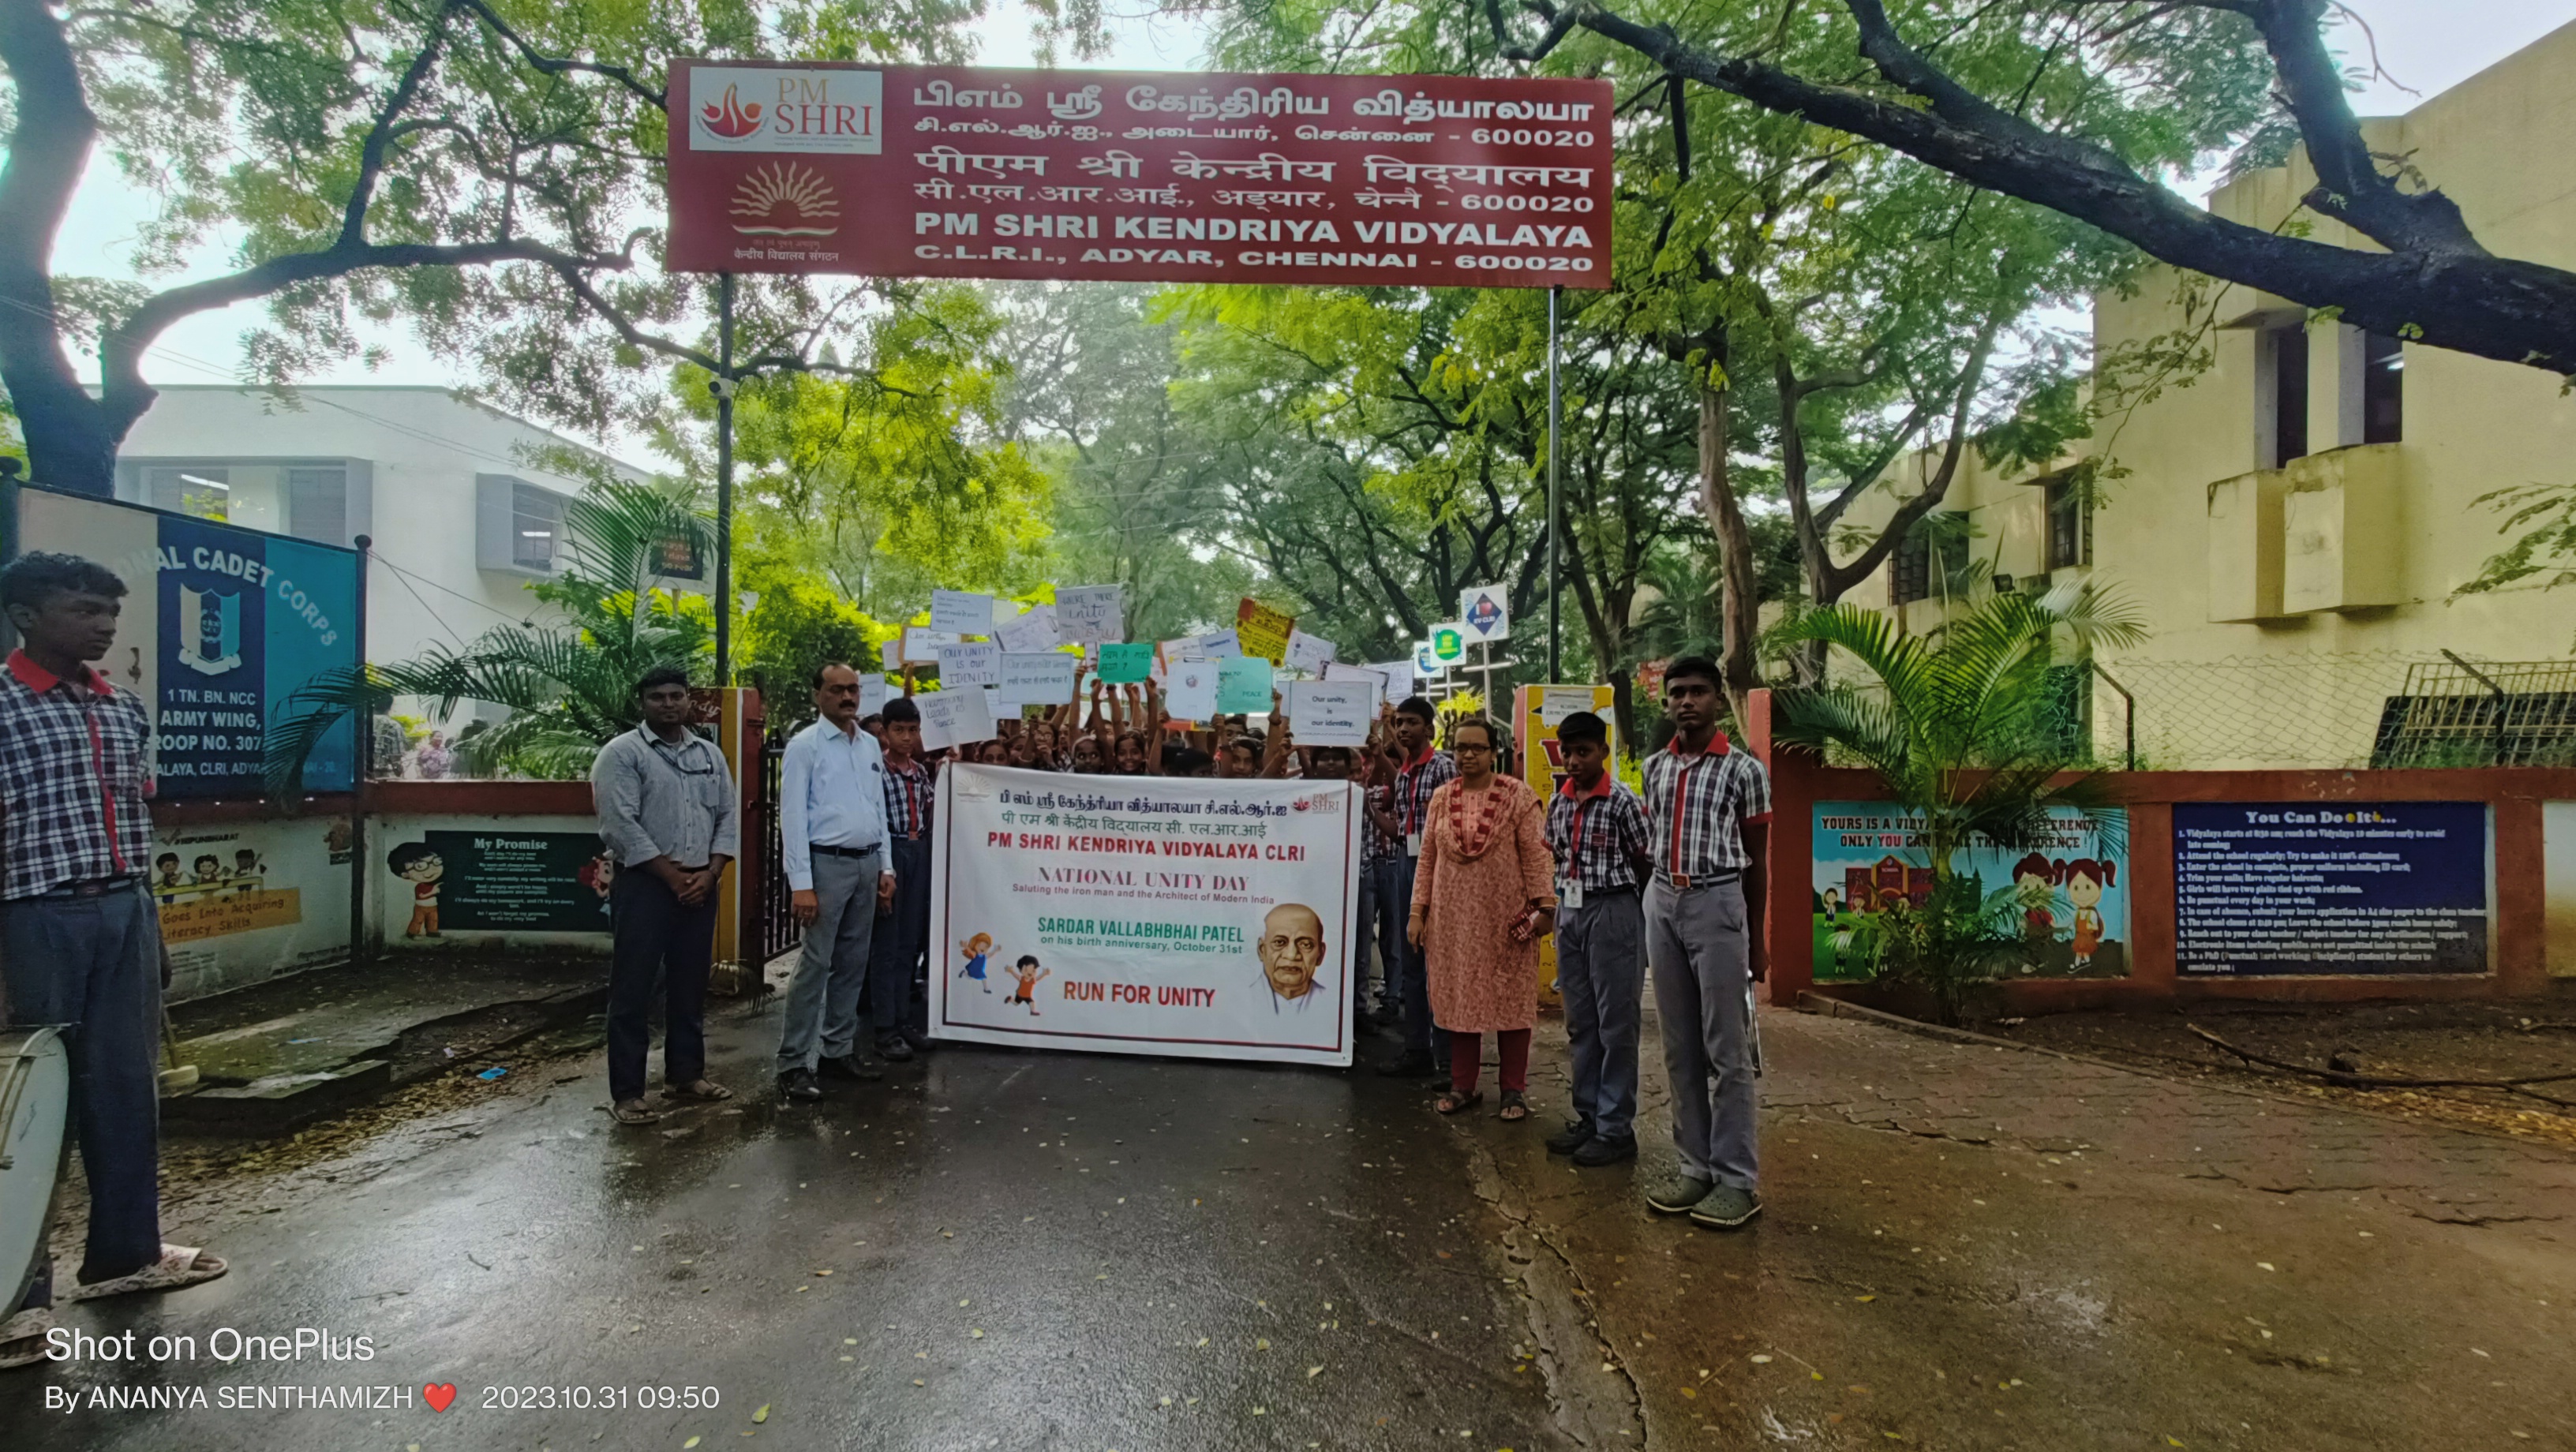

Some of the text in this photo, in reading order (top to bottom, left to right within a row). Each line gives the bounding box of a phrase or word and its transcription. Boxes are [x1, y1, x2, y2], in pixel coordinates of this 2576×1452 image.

[777, 77, 829, 103] PM
[914, 80, 1023, 108] பிஎம்
[1126, 85, 1328, 121] கேந்திரிய
[1353, 89, 1594, 125] வித்யாலயா
[775, 104, 874, 136] SHRI
[1295, 125, 1434, 143] சென்னை
[1471, 128, 1594, 147] 600020
[913, 145, 1050, 179] पीएम
[1076, 149, 1144, 179] श्री
[1170, 151, 1337, 182] केन्द्रीय
[1354, 186, 1422, 209] चेन्नै
[1461, 194, 1593, 212] 600020
[915, 212, 1593, 248] PM SHRI KENDRIYA VIDYALAYA
[768, 249, 805, 260] विद्यालय
[809, 250, 839, 261] संगठन
[915, 245, 1067, 265] C.L.R.I.,
[1080, 248, 1224, 268] ADYAR,
[1238, 252, 1417, 268] CHENNAI
[1455, 255, 1593, 271] 600020
[193, 547, 275, 588] CADET
[279, 579, 338, 646] CORPS
[1476, 604, 1480, 616] I
[168, 689, 256, 705] 1 TN. BN. NCC
[160, 710, 261, 730] ARMY WING,
[154, 735, 198, 750] ROOP
[203, 735, 231, 750] NO.
[157, 762, 265, 777] ALAYA, CLRI, ADYA
[1312, 800, 1339, 810] SHRI
[1002, 810, 1016, 825] पी
[1020, 814, 1041, 825] एम
[1045, 813, 1060, 826] श्री
[1822, 818, 1862, 829] YOURS
[1866, 818, 1878, 829] IS
[1883, 818, 1891, 829] A
[2246, 811, 2279, 824] You
[2283, 811, 2316, 824] Can
[2320, 811, 2343, 824] Do
[474, 838, 548, 851] My Promise
[987, 832, 1305, 861] PM SHRI KENDRIYA VIDYALAYA CLRI
[1840, 835, 1873, 848] ONLY
[1878, 835, 1902, 848] YOU
[1905, 836, 1931, 848] CAN
[1038, 867, 1249, 891] NATIONAL UNITY DAY
[1013, 883, 1051, 895] Saluting
[1155, 891, 1197, 900] Architect
[1213, 893, 1248, 903] Modern
[1252, 896, 1274, 904] India
[163, 911, 191, 925] Goes
[232, 899, 284, 915] Acquiring
[1038, 917, 1245, 942] SARDAR VALLABHBHAI PATEL
[1058, 936, 1073, 945] his
[1077, 937, 1101, 946] birth
[1106, 939, 1170, 952] anniversary,
[1174, 941, 1216, 952] October
[1219, 945, 1242, 954] 31st
[1064, 981, 1215, 1008] RUN FOR UNITY
